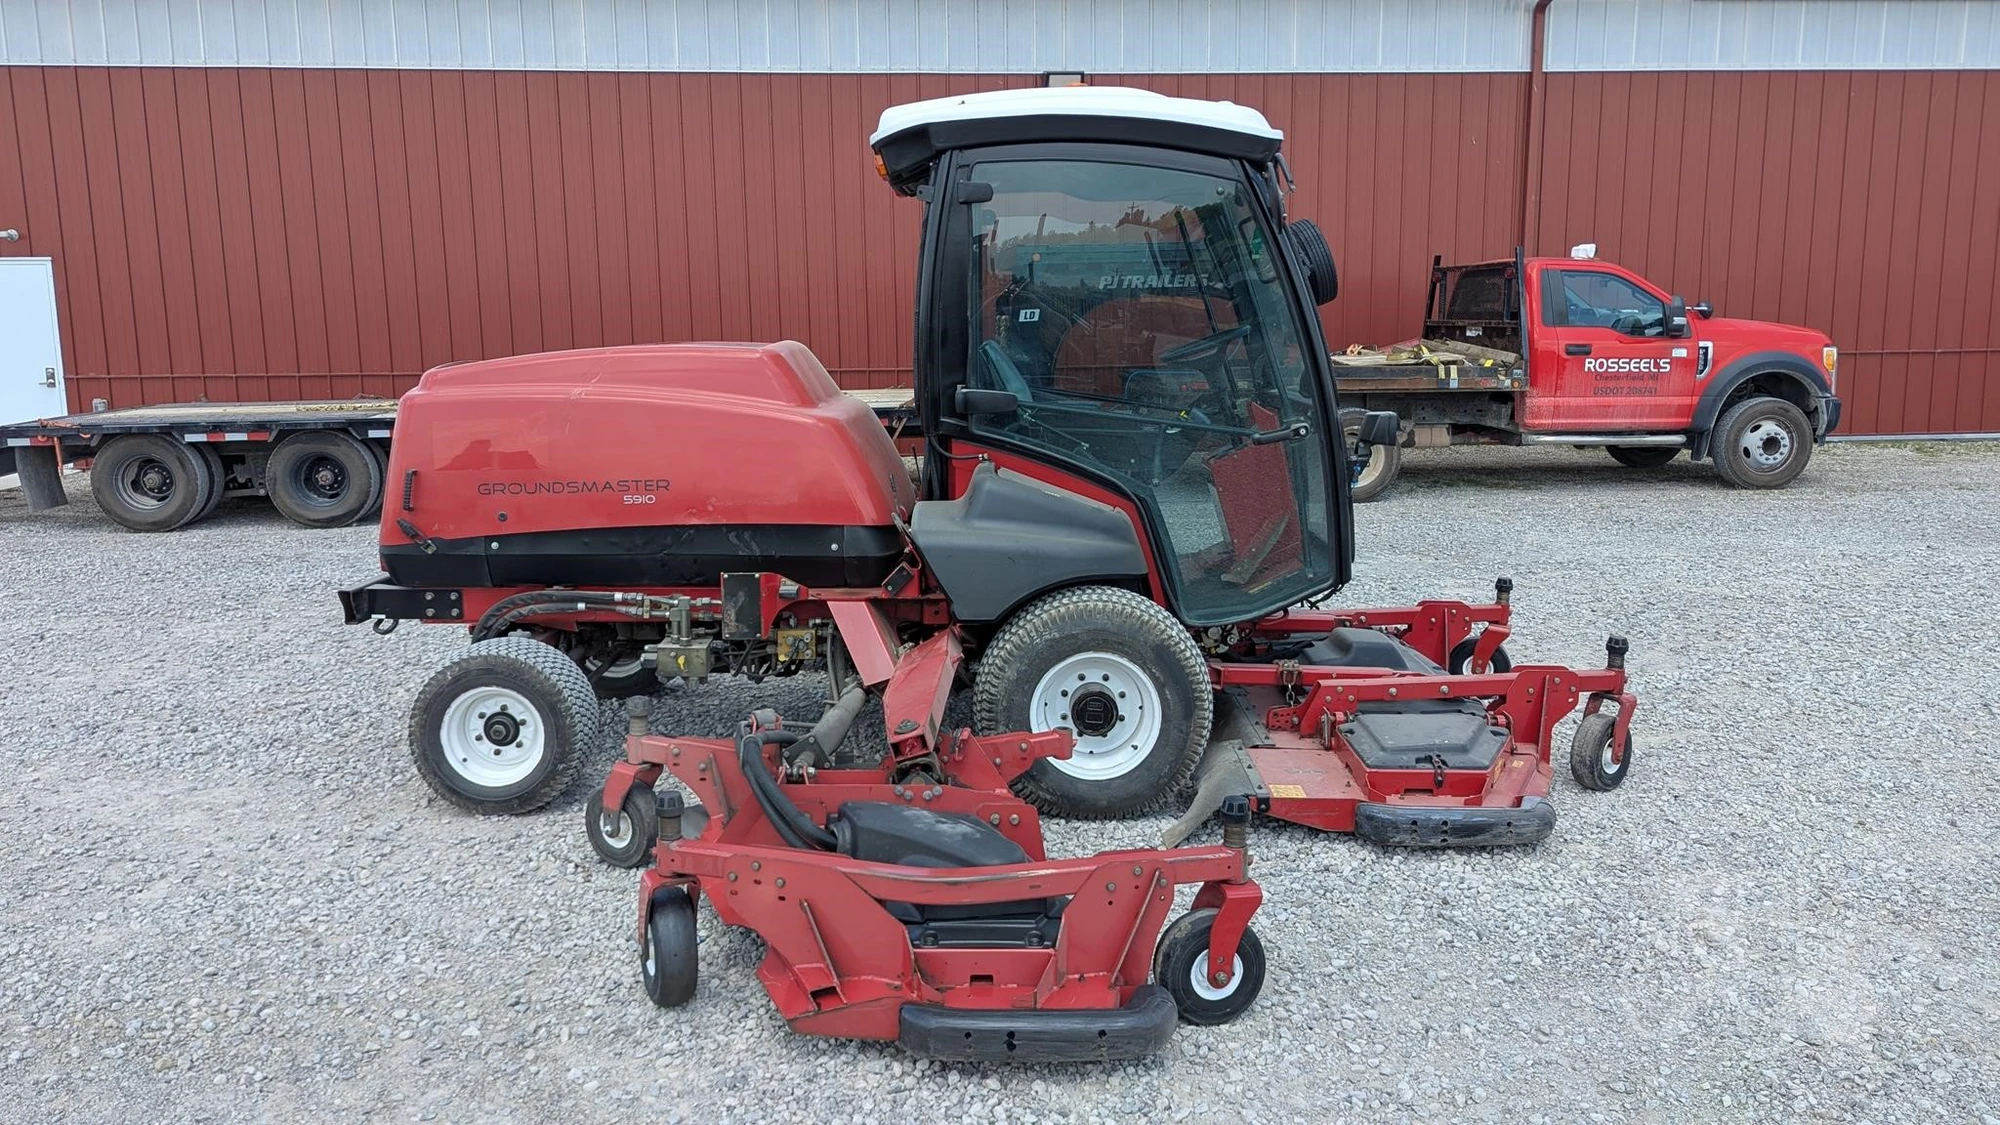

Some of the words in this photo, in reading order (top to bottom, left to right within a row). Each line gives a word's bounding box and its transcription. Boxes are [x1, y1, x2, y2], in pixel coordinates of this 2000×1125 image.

[1099, 274, 1119, 289] PJ
[1121, 273, 1209, 289] TRAILERS
[1023, 311, 1036, 320] LD
[1584, 358, 1671, 372] ROSSEEL'S
[1593, 386, 1625, 396] USDOT
[477, 479, 671, 496] GROUNDSMASTER
[623, 495, 656, 505] 5910
